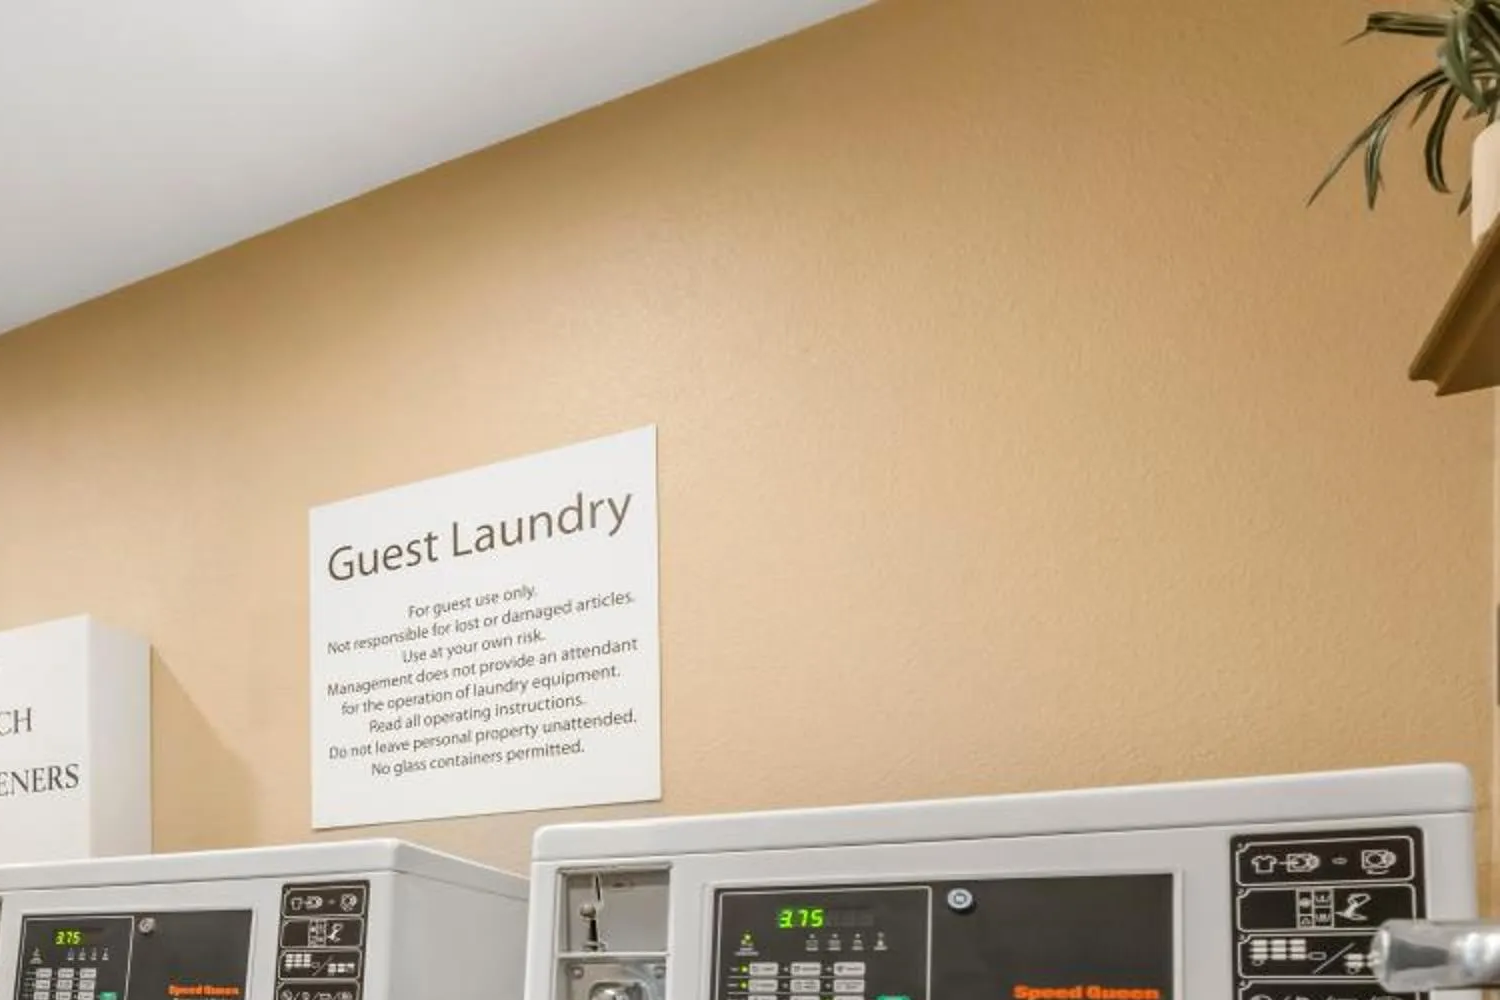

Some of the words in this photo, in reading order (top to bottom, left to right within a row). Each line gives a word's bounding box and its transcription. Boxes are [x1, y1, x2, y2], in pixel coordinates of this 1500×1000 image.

[328, 530, 439, 582] Guest
[452, 492, 633, 557] Laundry
[327, 641, 350, 654] Not
[354, 626, 428, 650] responsible
[432, 622, 451, 637] for
[455, 617, 479, 632] lost
[483, 615, 499, 627] or
[501, 601, 572, 624] damaged
[408, 605, 430, 618] For
[433, 597, 471, 616] guest
[475, 593, 499, 607] use
[327, 672, 413, 697] Management
[416, 668, 449, 684] does
[452, 663, 476, 677] not
[479, 653, 535, 676] provide
[539, 651, 556, 664] an
[561, 638, 638, 661] attendant
[403, 650, 427, 663] Use
[430, 646, 443, 659] at
[447, 642, 478, 658] your
[482, 637, 512, 650] own
[517, 628, 546, 644] risk.
[341, 701, 359, 715] for
[363, 699, 384, 713] the
[387, 690, 452, 711] operation
[455, 684, 471, 699] of
[473, 678, 528, 697] laundry
[532, 665, 620, 690] equipment.
[329, 746, 347, 759] Do
[351, 743, 372, 757] not
[376, 740, 410, 755] leave
[413, 730, 472, 751] personal
[475, 723, 538, 744] property
[542, 708, 637, 734] unattended.
[369, 718, 402, 733] Read
[405, 713, 420, 729] all
[423, 705, 491, 727] operating
[495, 695, 587, 717] instructions.
[371, 763, 390, 776] No
[393, 760, 427, 776] glass
[429, 751, 502, 769] containers
[506, 740, 585, 763] permitted.
[1013, 984, 1083, 1000] Speed
[1086, 985, 1161, 1000] Queen
